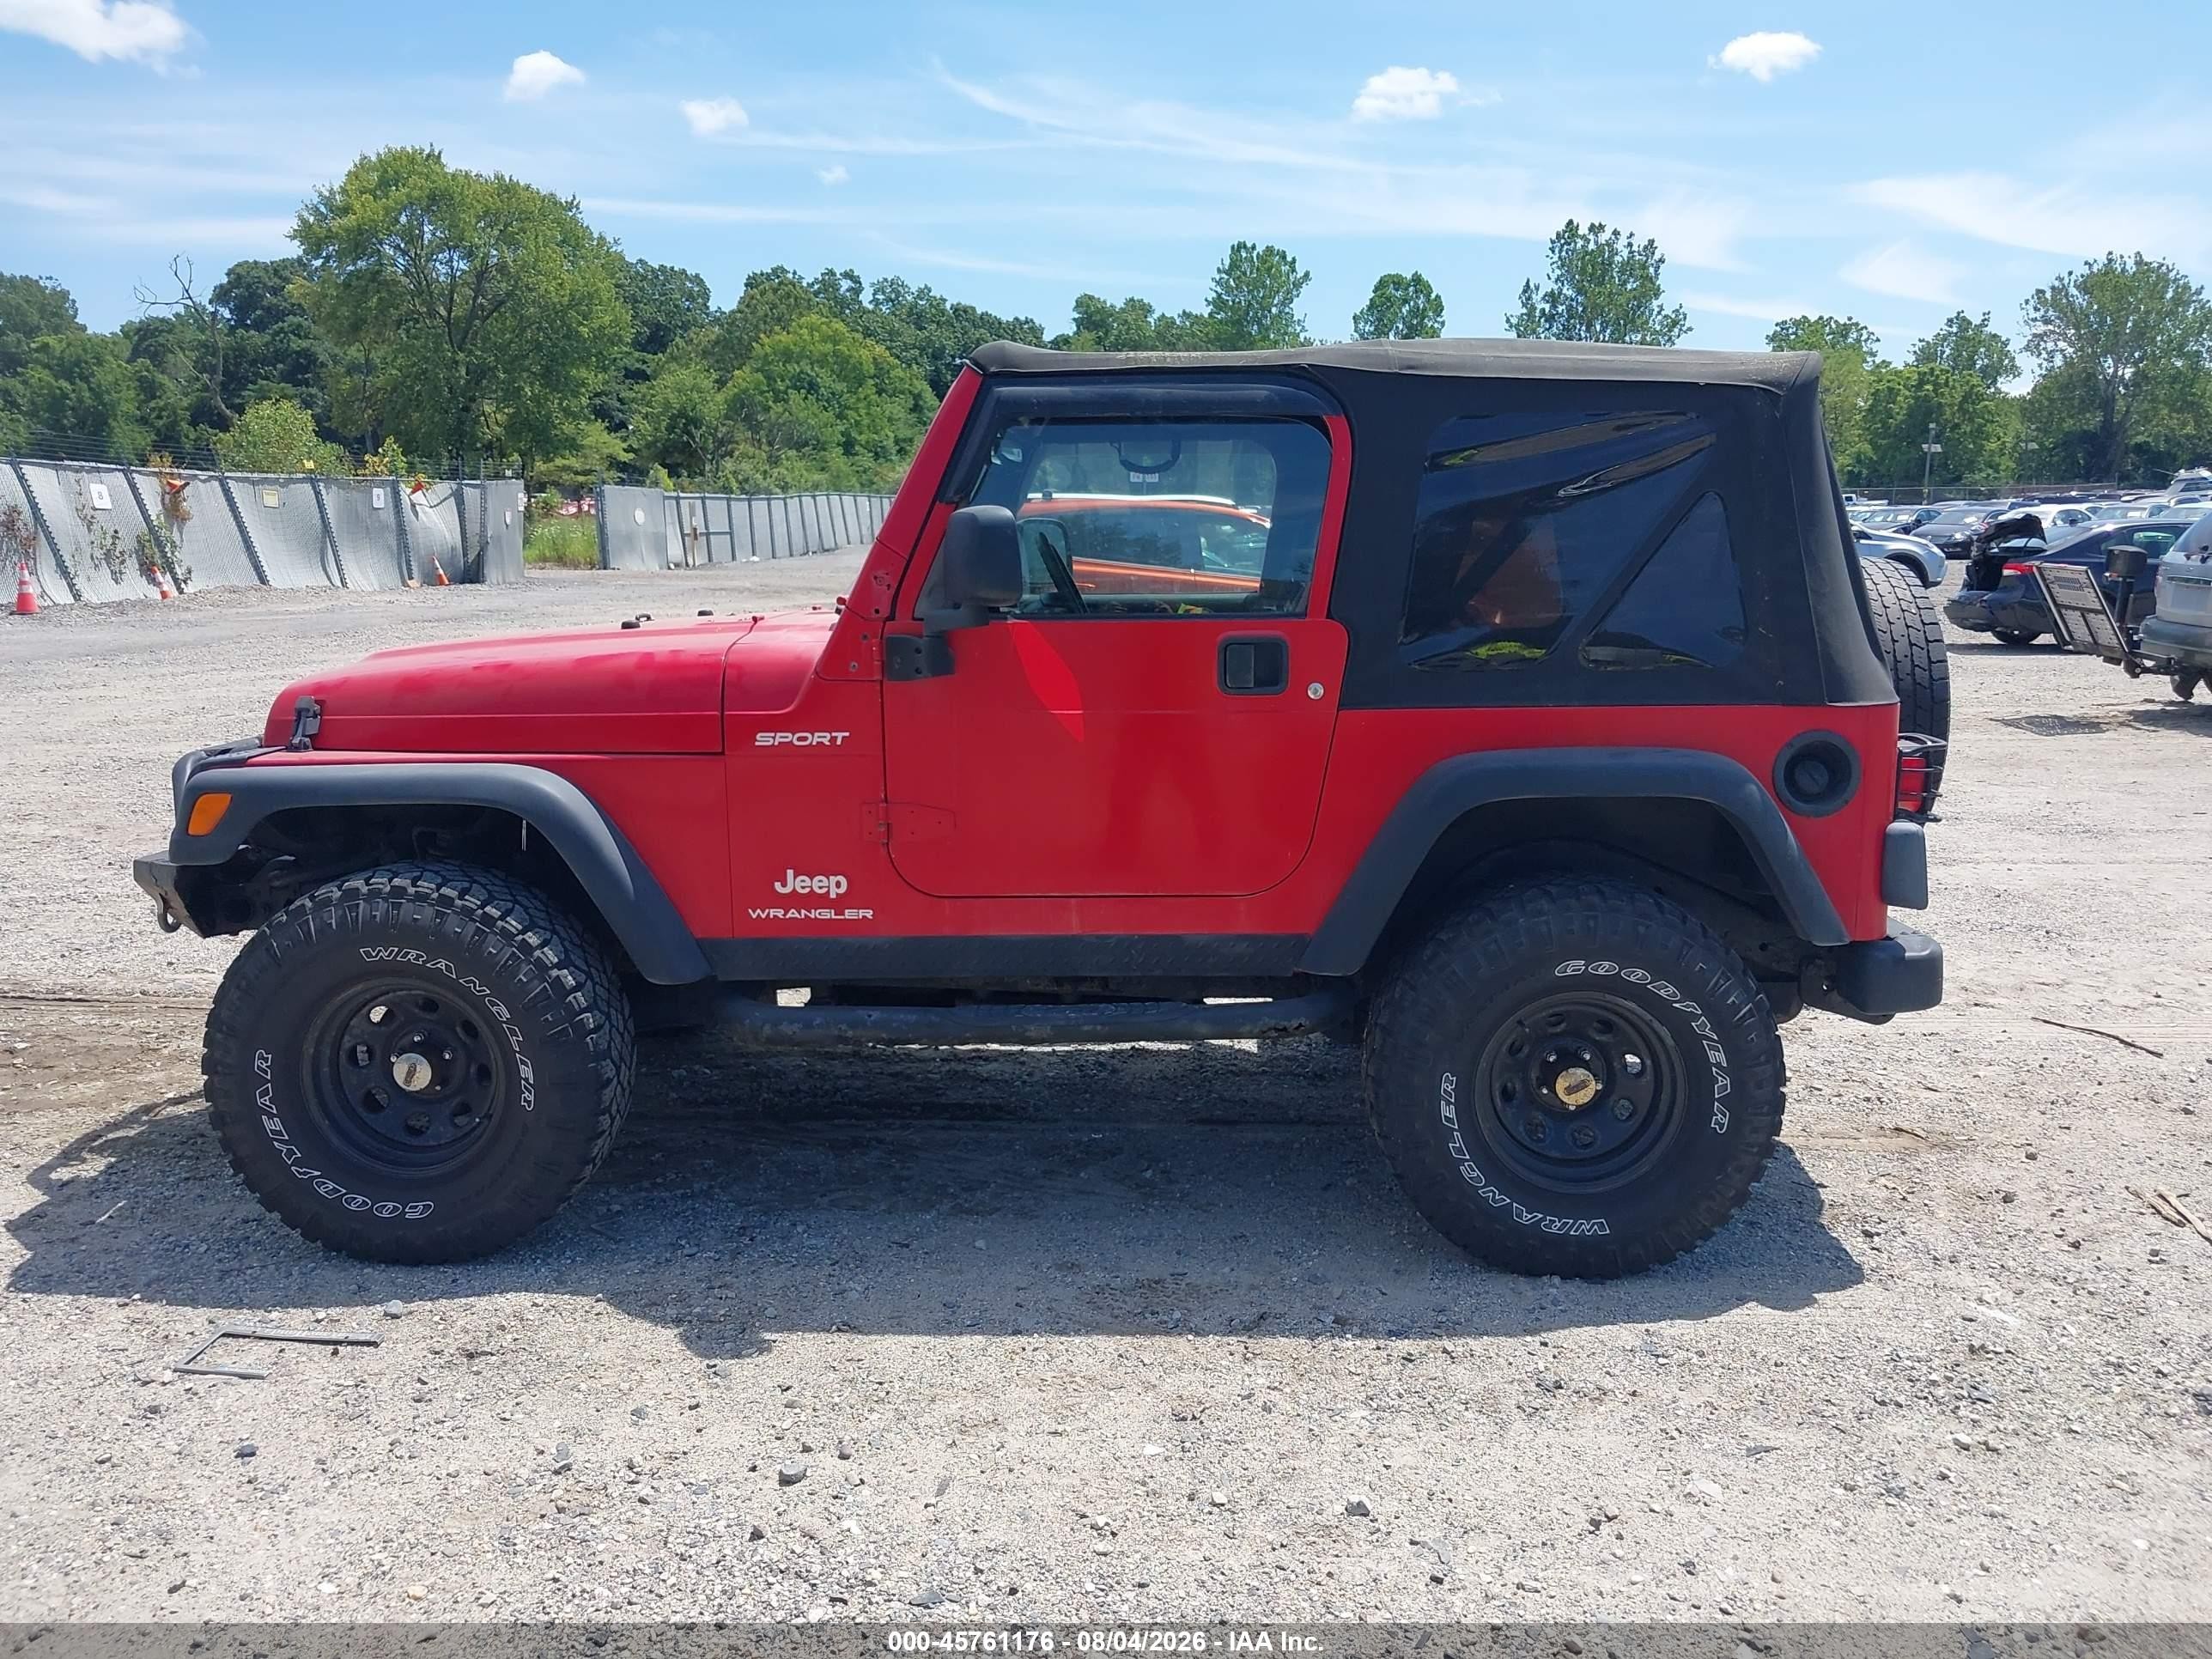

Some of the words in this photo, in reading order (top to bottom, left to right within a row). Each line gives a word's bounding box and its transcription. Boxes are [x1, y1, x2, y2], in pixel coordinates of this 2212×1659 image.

[97, 490, 104, 500] 8
[755, 732, 850, 745] SPORT
[748, 908, 874, 919] WRANGLER
[775, 869, 848, 898] Jeep
[359, 946, 535, 1112] WRANGLER
[1554, 960, 1731, 1134] GOODYEAR
[254, 1048, 434, 1219] GOODYEAR
[1440, 1072, 1610, 1236] WRANGLER
